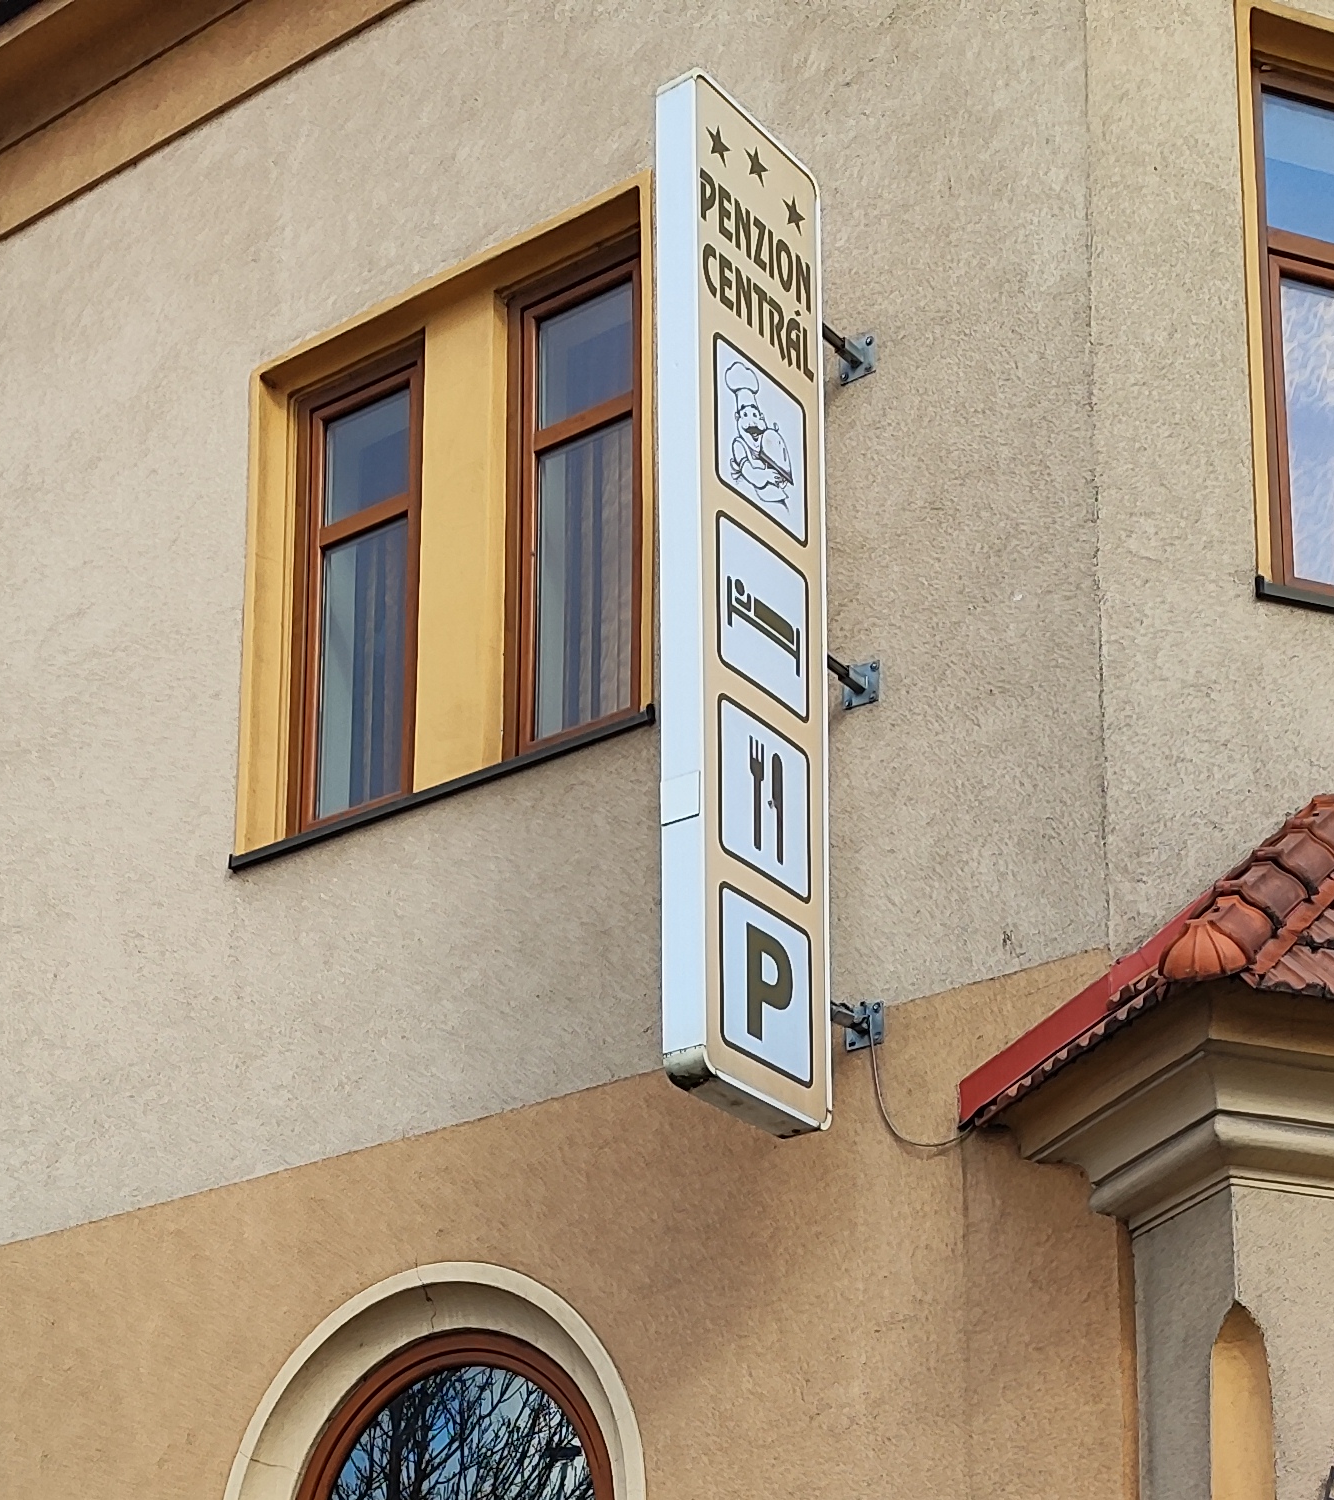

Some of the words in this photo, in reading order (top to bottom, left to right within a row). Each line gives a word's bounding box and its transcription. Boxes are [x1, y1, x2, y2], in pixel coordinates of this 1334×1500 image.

[699, 166, 812, 314] PENZION
[702, 243, 815, 383] CENTRÁL
[746, 922, 794, 1042] P
